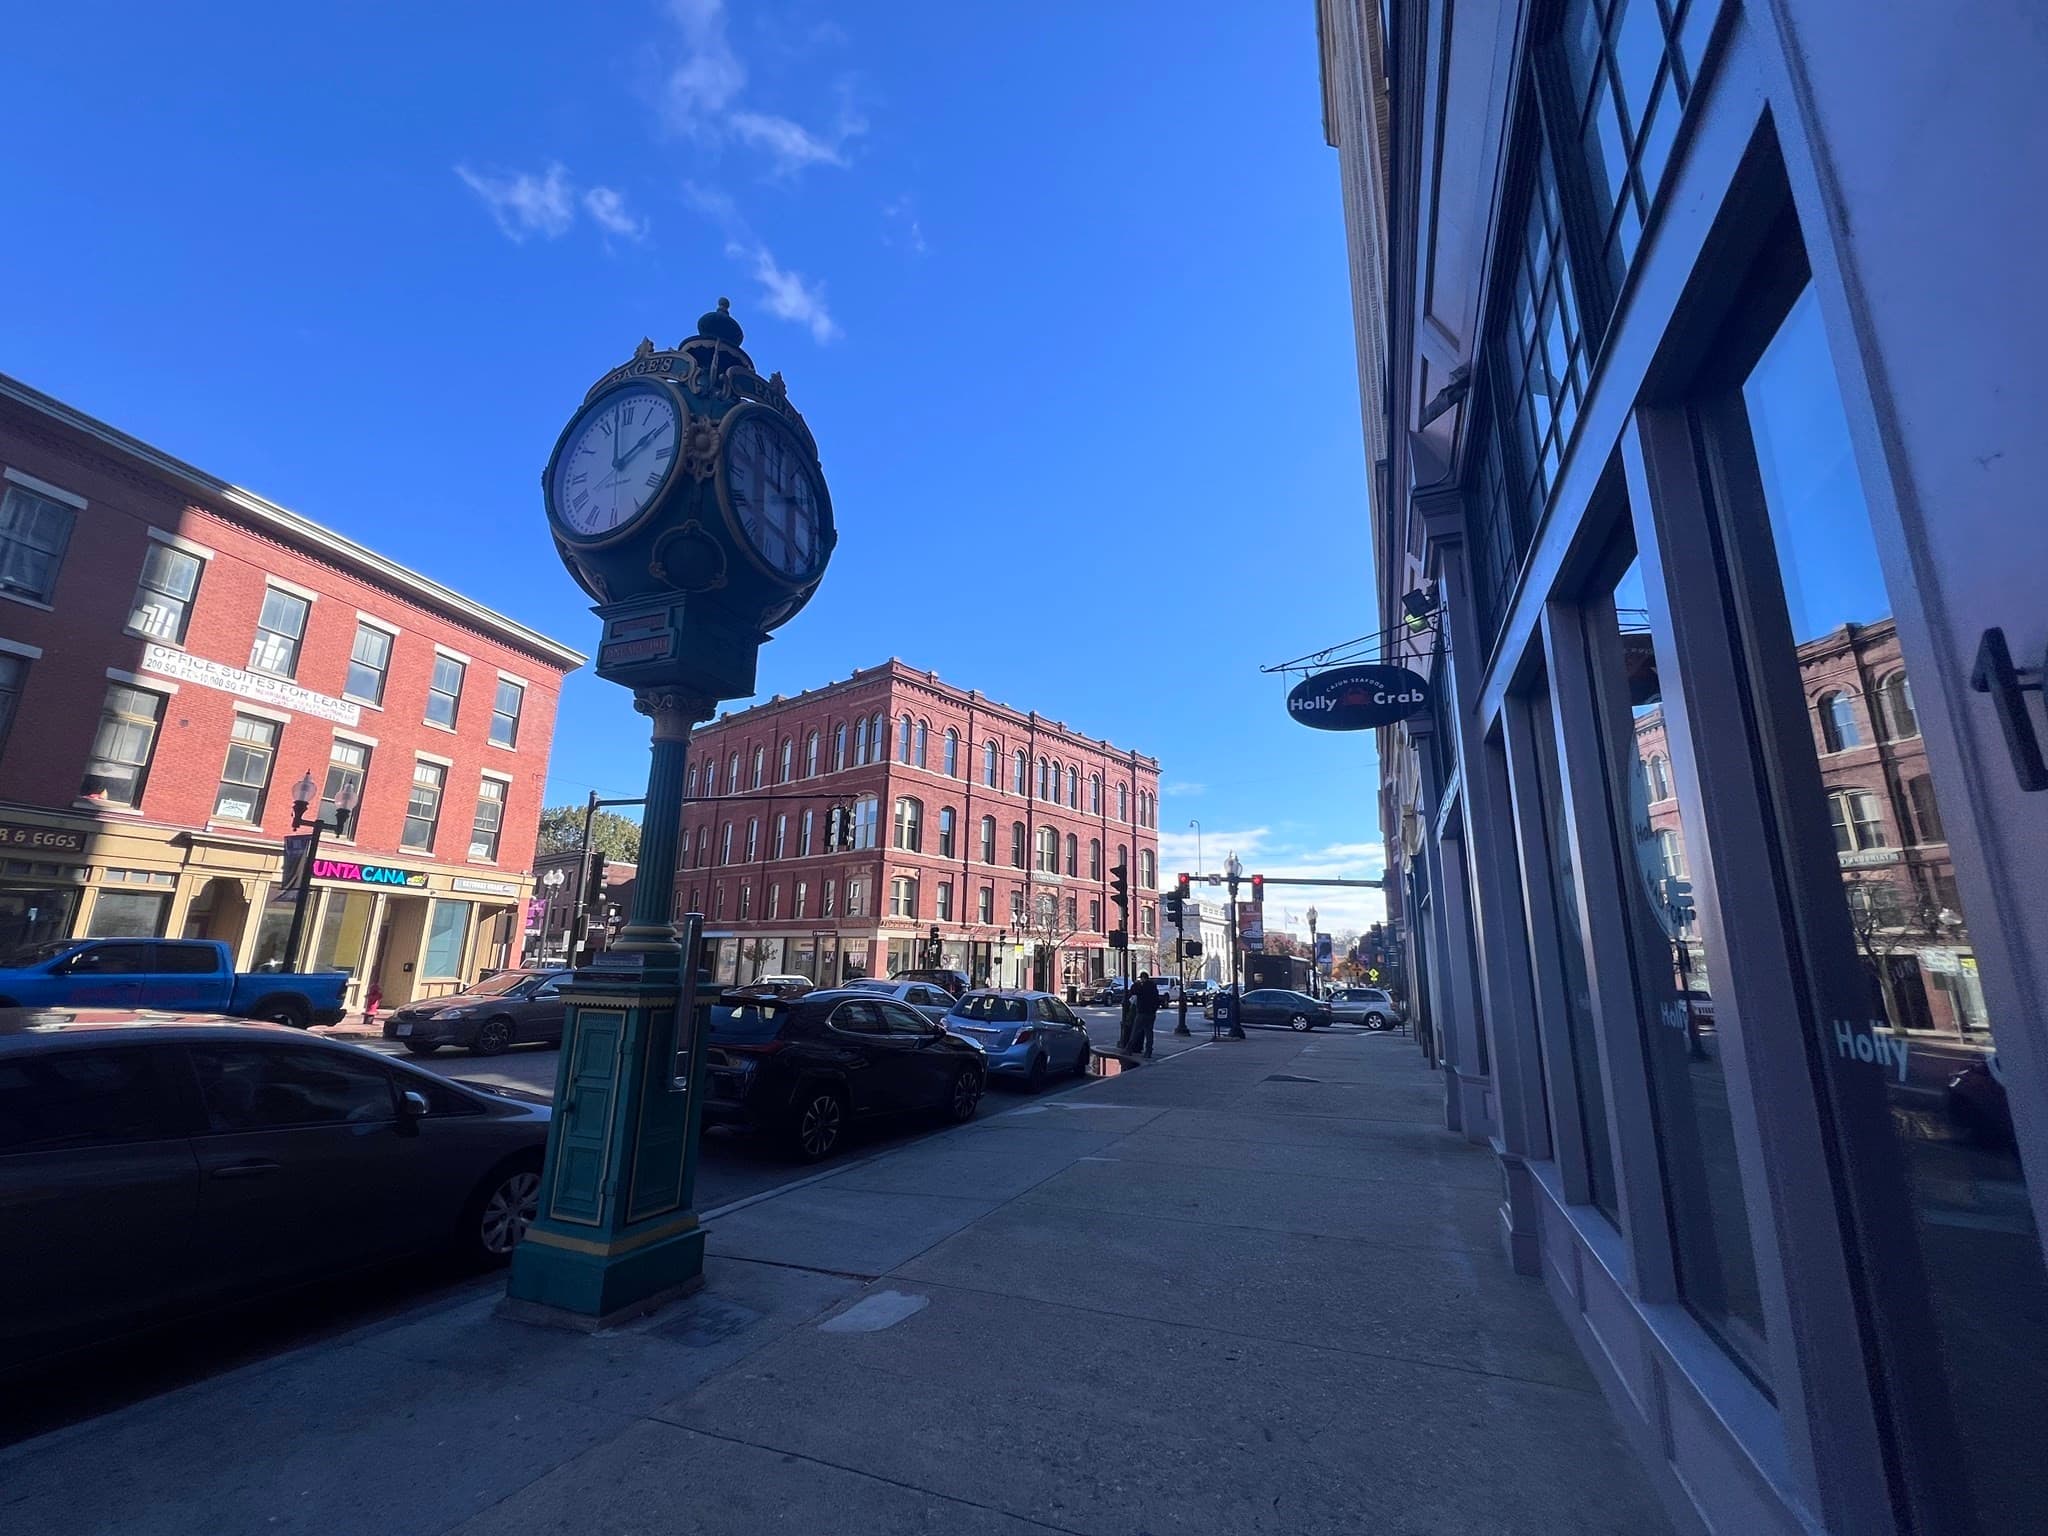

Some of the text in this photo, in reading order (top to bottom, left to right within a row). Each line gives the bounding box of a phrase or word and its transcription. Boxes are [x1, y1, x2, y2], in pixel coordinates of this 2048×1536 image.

[146, 658, 163, 670] 200
[153, 647, 216, 672] OFFICE
[221, 667, 275, 690] SUITES
[280, 683, 309, 699] FOR
[314, 694, 356, 713] LEASE
[1326, 678, 1384, 692] CAJUN SEAFOOD
[1290, 689, 1424, 712] Holly Crab
[33, 832, 77, 848] EGGS
[1833, 1019, 1908, 1082] Holly
